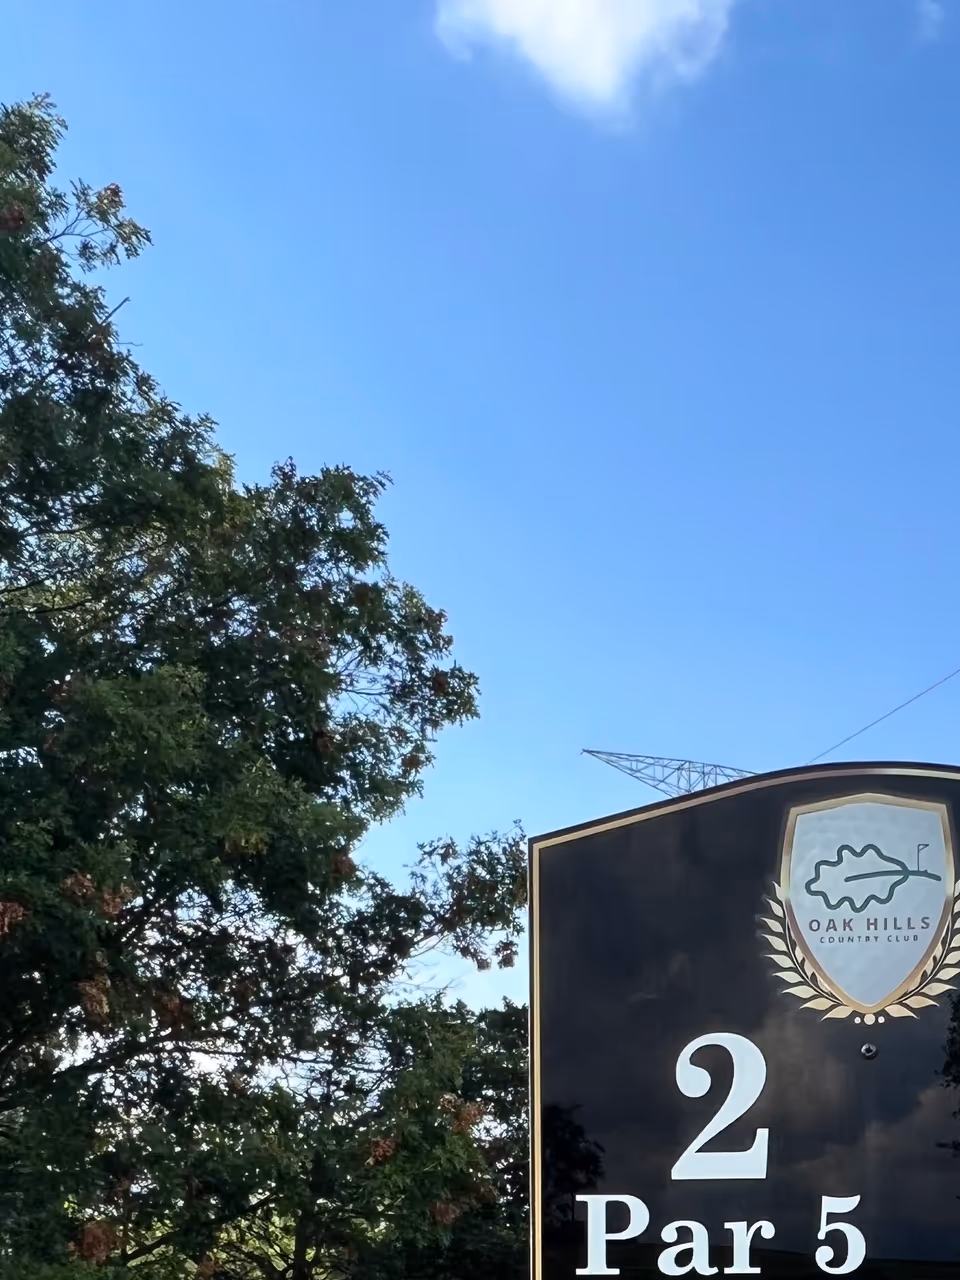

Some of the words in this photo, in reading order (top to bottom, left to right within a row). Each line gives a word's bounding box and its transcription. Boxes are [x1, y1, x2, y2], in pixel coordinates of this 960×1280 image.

[808, 918, 853, 932] OAK
[866, 916, 930, 931] HILLS
[820, 935, 879, 944] COUNTRY
[887, 934, 918, 943] CLUB
[671, 1033, 769, 1179] 2
[576, 1195, 775, 1276] Par
[816, 1195, 866, 1275] 5
